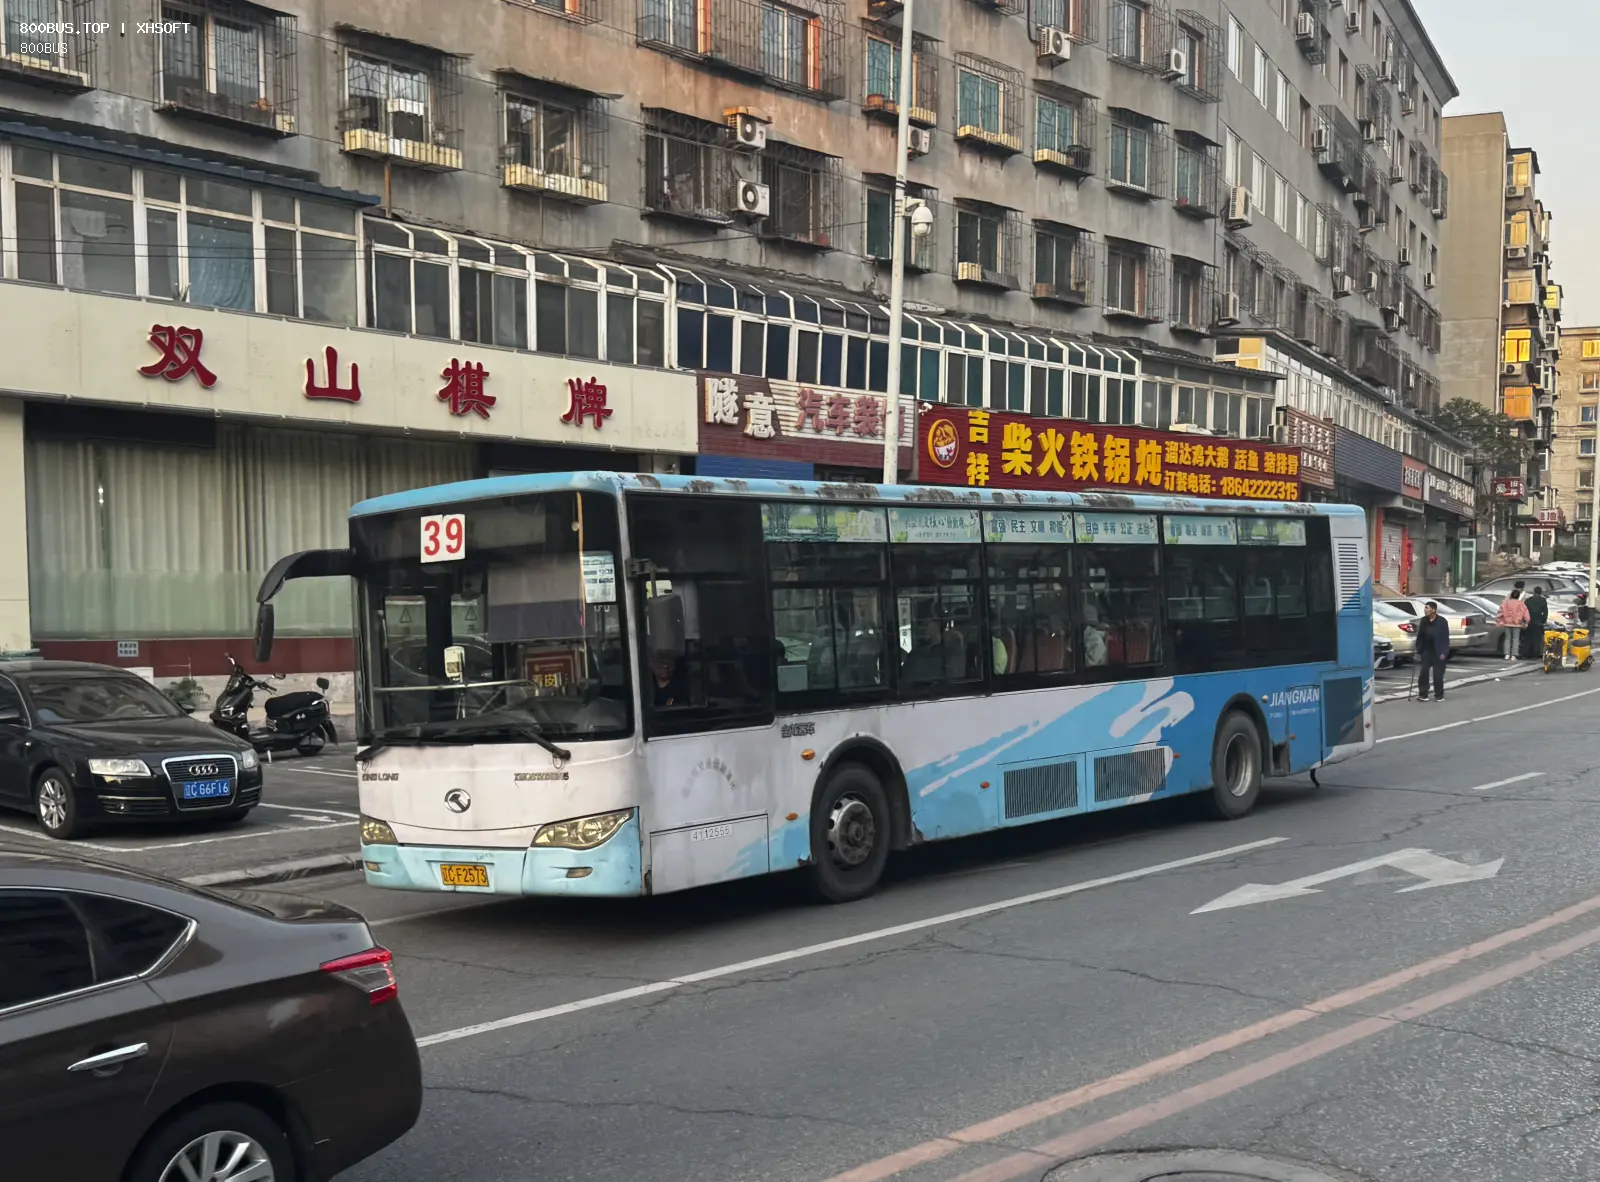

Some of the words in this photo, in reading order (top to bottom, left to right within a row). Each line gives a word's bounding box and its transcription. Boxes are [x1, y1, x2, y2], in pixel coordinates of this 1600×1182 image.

[138, 323, 614, 430] 双山棋牌
[966, 408, 990, 486] 吉祥
[1001, 422, 1163, 486] 柴火铁锅炖
[1233, 448, 1259, 472] 活鱼
[423, 517, 464, 556] 39
[1269, 687, 1320, 707] JIANGNAN
